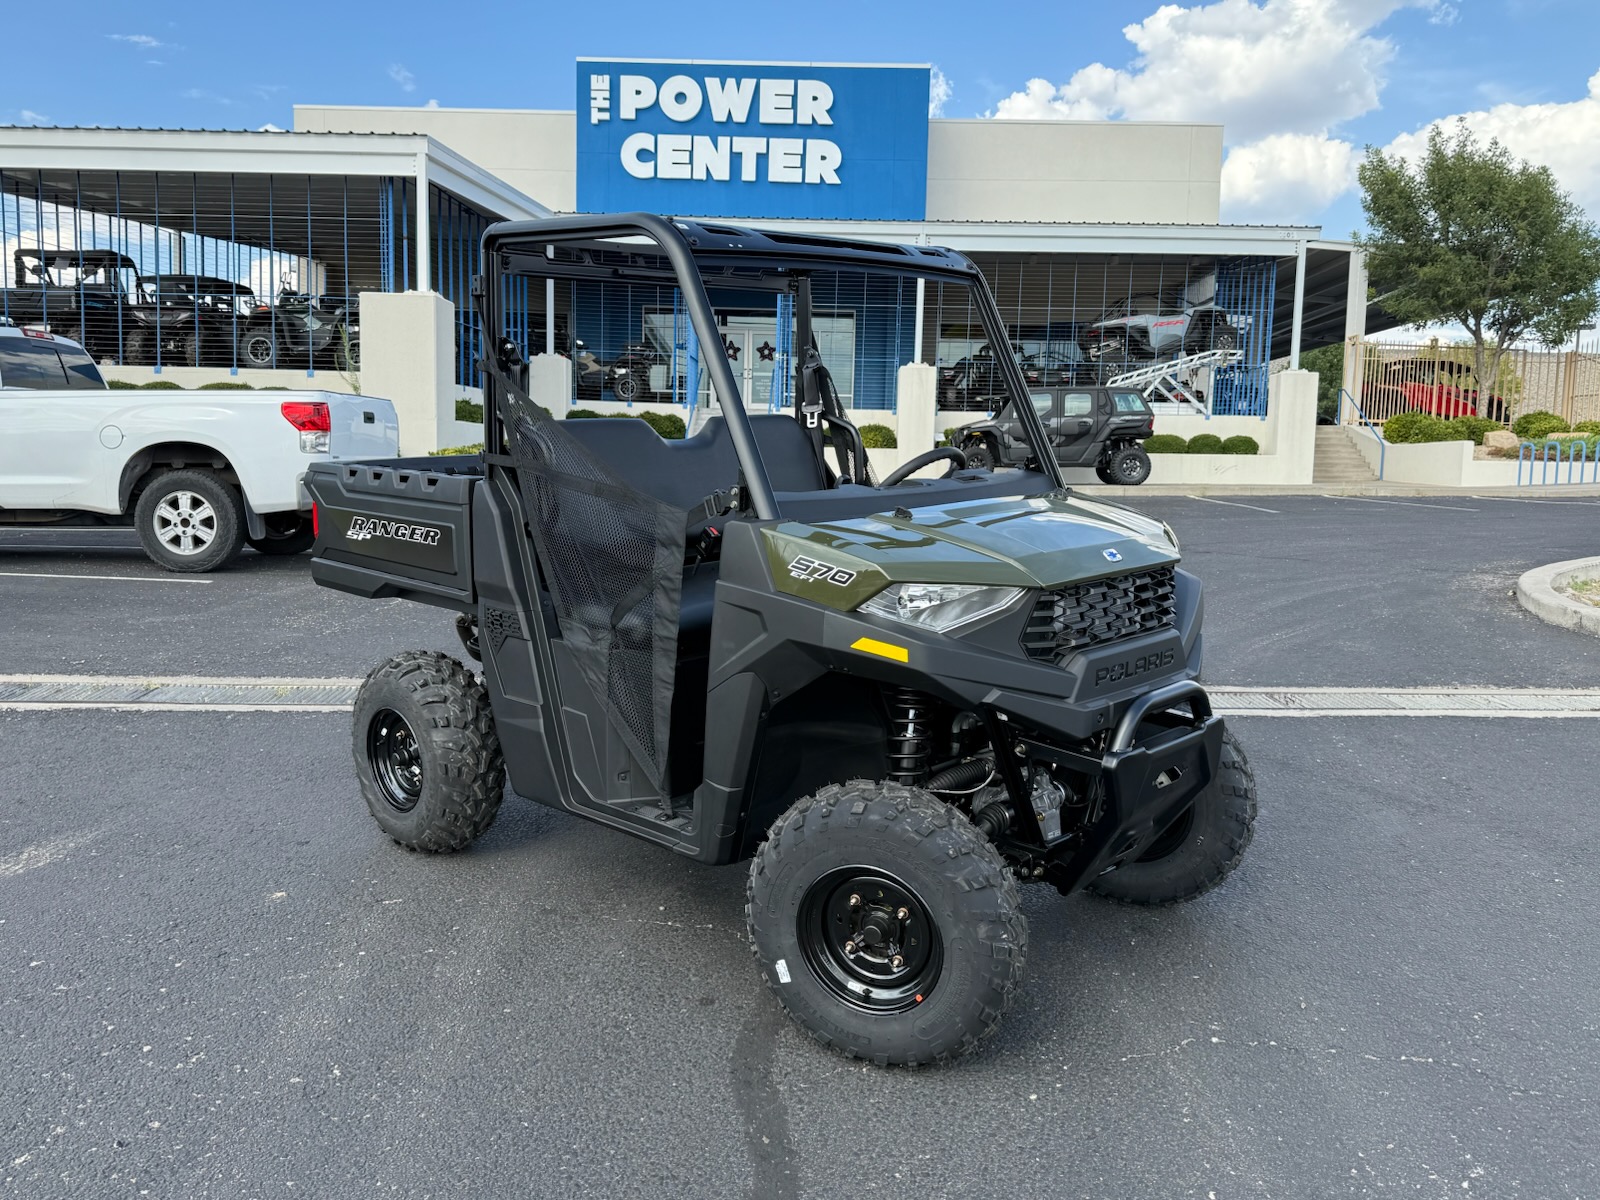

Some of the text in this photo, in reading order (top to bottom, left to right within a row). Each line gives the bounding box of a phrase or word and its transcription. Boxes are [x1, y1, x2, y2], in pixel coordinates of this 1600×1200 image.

[590, 74, 610, 125] THE
[619, 74, 834, 126] POWER
[619, 131, 842, 185] CENTER
[345, 530, 372, 541] SP
[350, 515, 441, 546] RANGER
[787, 554, 857, 587] 570
[789, 570, 815, 583] EFI
[1095, 647, 1175, 688] POLARIS
